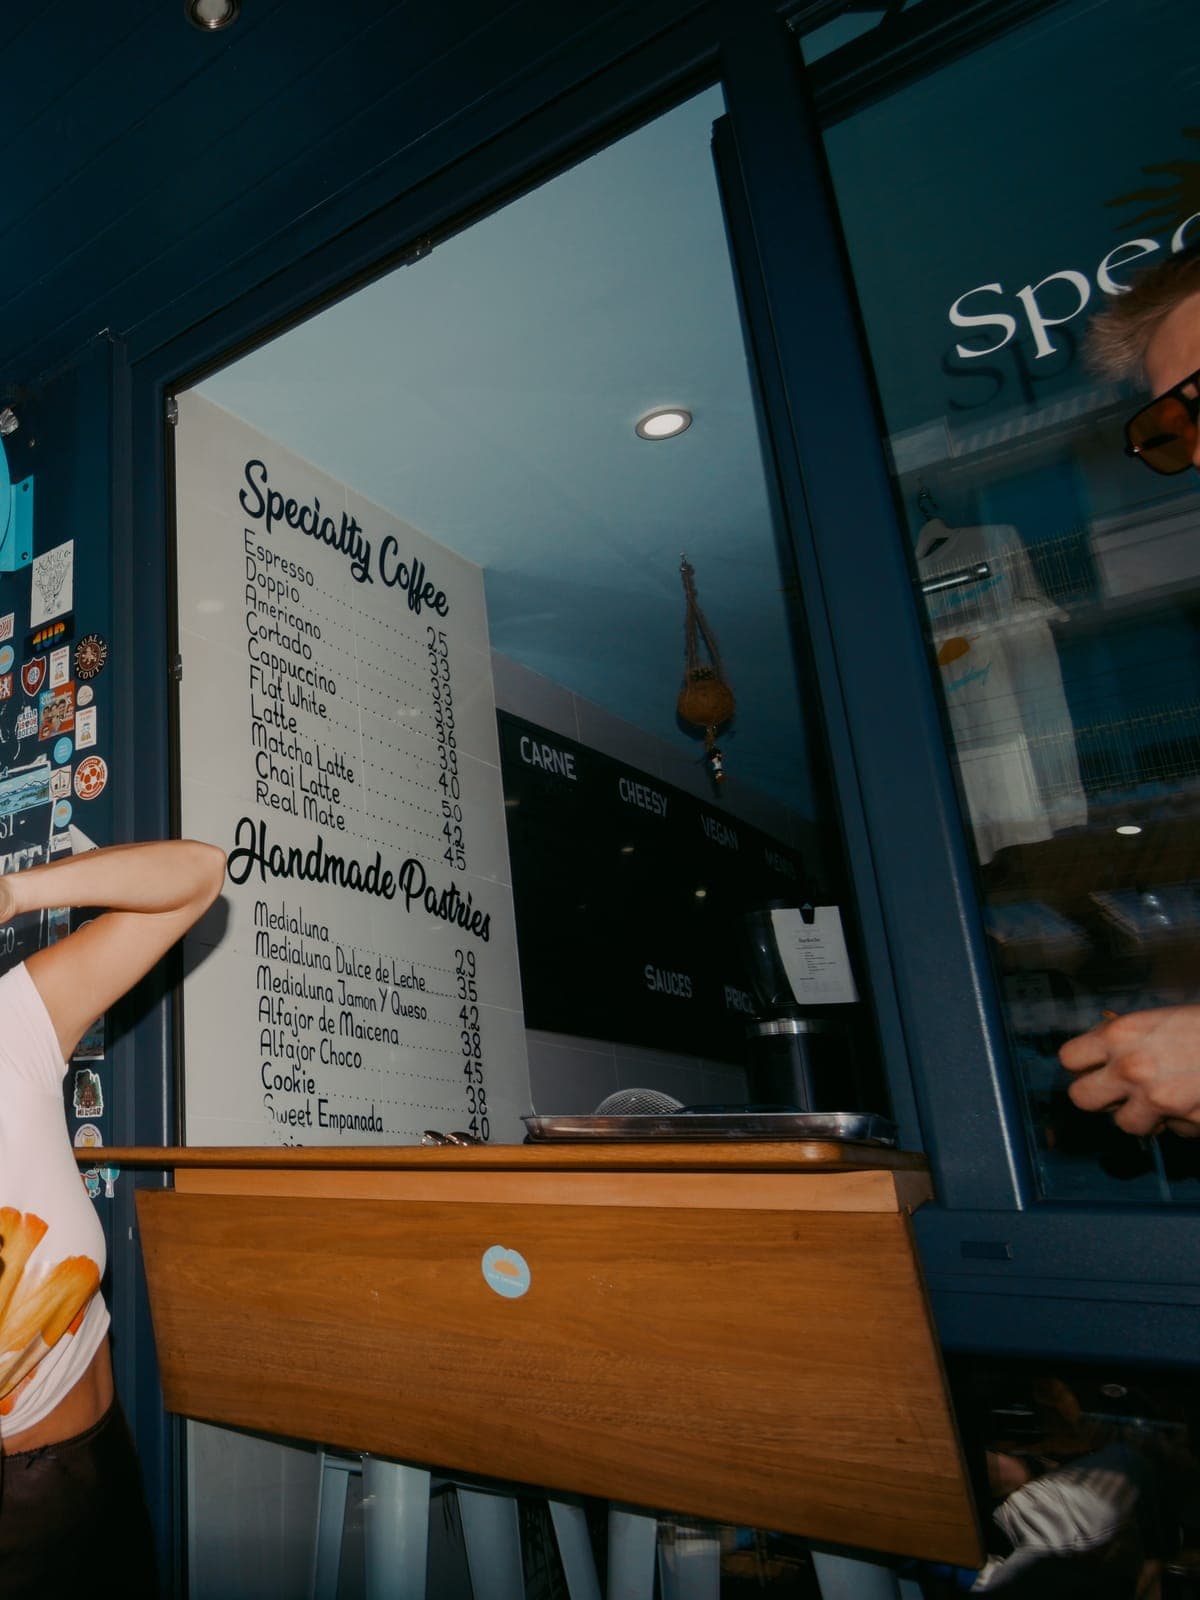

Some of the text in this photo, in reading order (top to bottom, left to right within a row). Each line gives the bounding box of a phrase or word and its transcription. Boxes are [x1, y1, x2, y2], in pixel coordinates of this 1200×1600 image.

[238, 459, 450, 618] Specialty Coffee
[244, 528, 314, 587] Espresso
[246, 556, 300, 605] Doppio
[245, 584, 322, 640] Americano
[246, 611, 313, 661] Cortado
[248, 637, 337, 696] Cappuccino
[250, 664, 285, 702] Flat
[287, 681, 328, 719] White
[251, 693, 298, 734] Latte
[251, 721, 314, 768] Matcha
[316, 744, 355, 784] Latte
[255, 751, 295, 789] Chai
[300, 763, 341, 805] Latte
[520, 736, 578, 781] CARNE
[256, 780, 299, 817] Real
[303, 796, 346, 832] Mate
[619, 777, 668, 818] CHEESY
[700, 813, 740, 851] VEGAN
[227, 817, 492, 942] Handmade Pastries
[254, 900, 476, 978] Medialuna 2.9
[255, 930, 478, 1003] Medialuna Dulce de Leche 3.5
[257, 965, 481, 1031] Medialuna Jamon Y Queso 4.2
[644, 963, 693, 999] SAUCES
[259, 995, 482, 1059] Alfajor de Maicena 3.8
[260, 1028, 484, 1085] Alfajor Choco 4.5
[261, 1061, 317, 1095] Cookie
[263, 1093, 313, 1127] Sweet
[318, 1098, 384, 1135] Empanada
